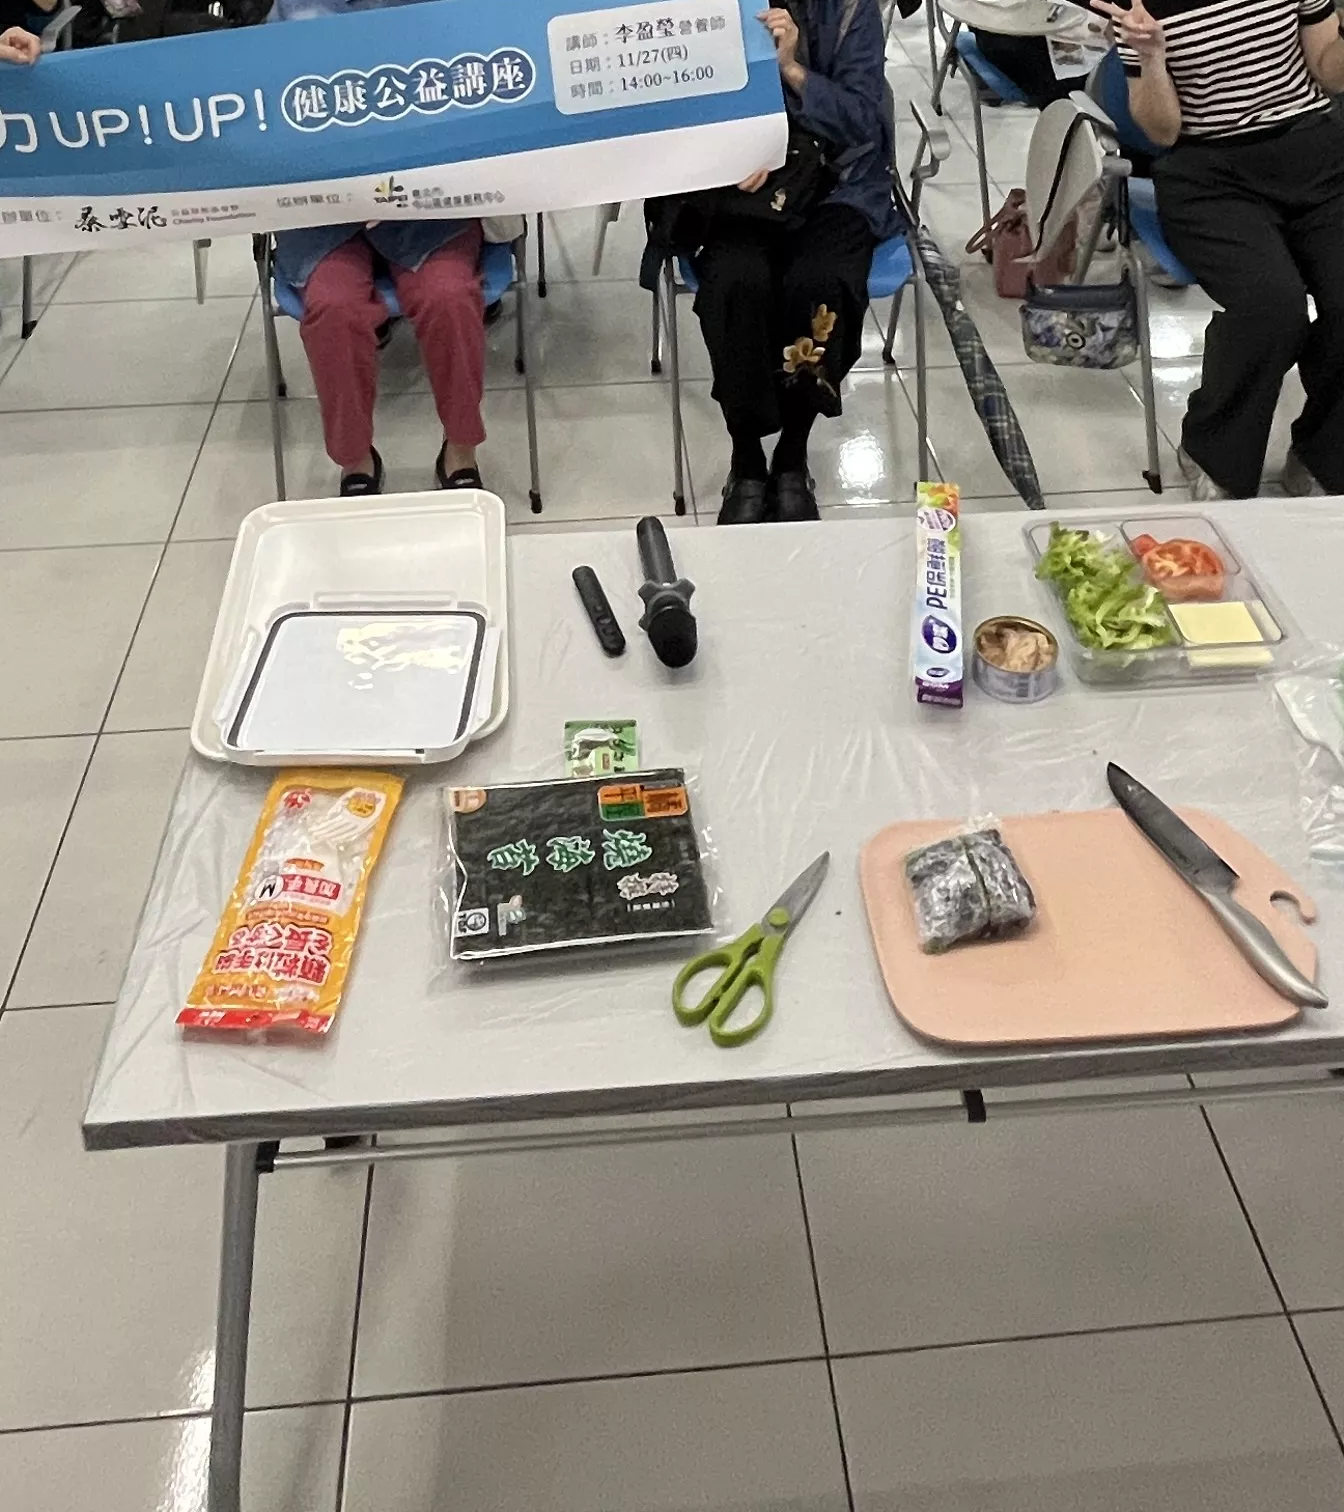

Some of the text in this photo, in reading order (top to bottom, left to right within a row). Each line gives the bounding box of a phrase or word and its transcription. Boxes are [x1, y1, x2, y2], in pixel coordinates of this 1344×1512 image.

[291, 55, 528, 123] 健康公益講座
